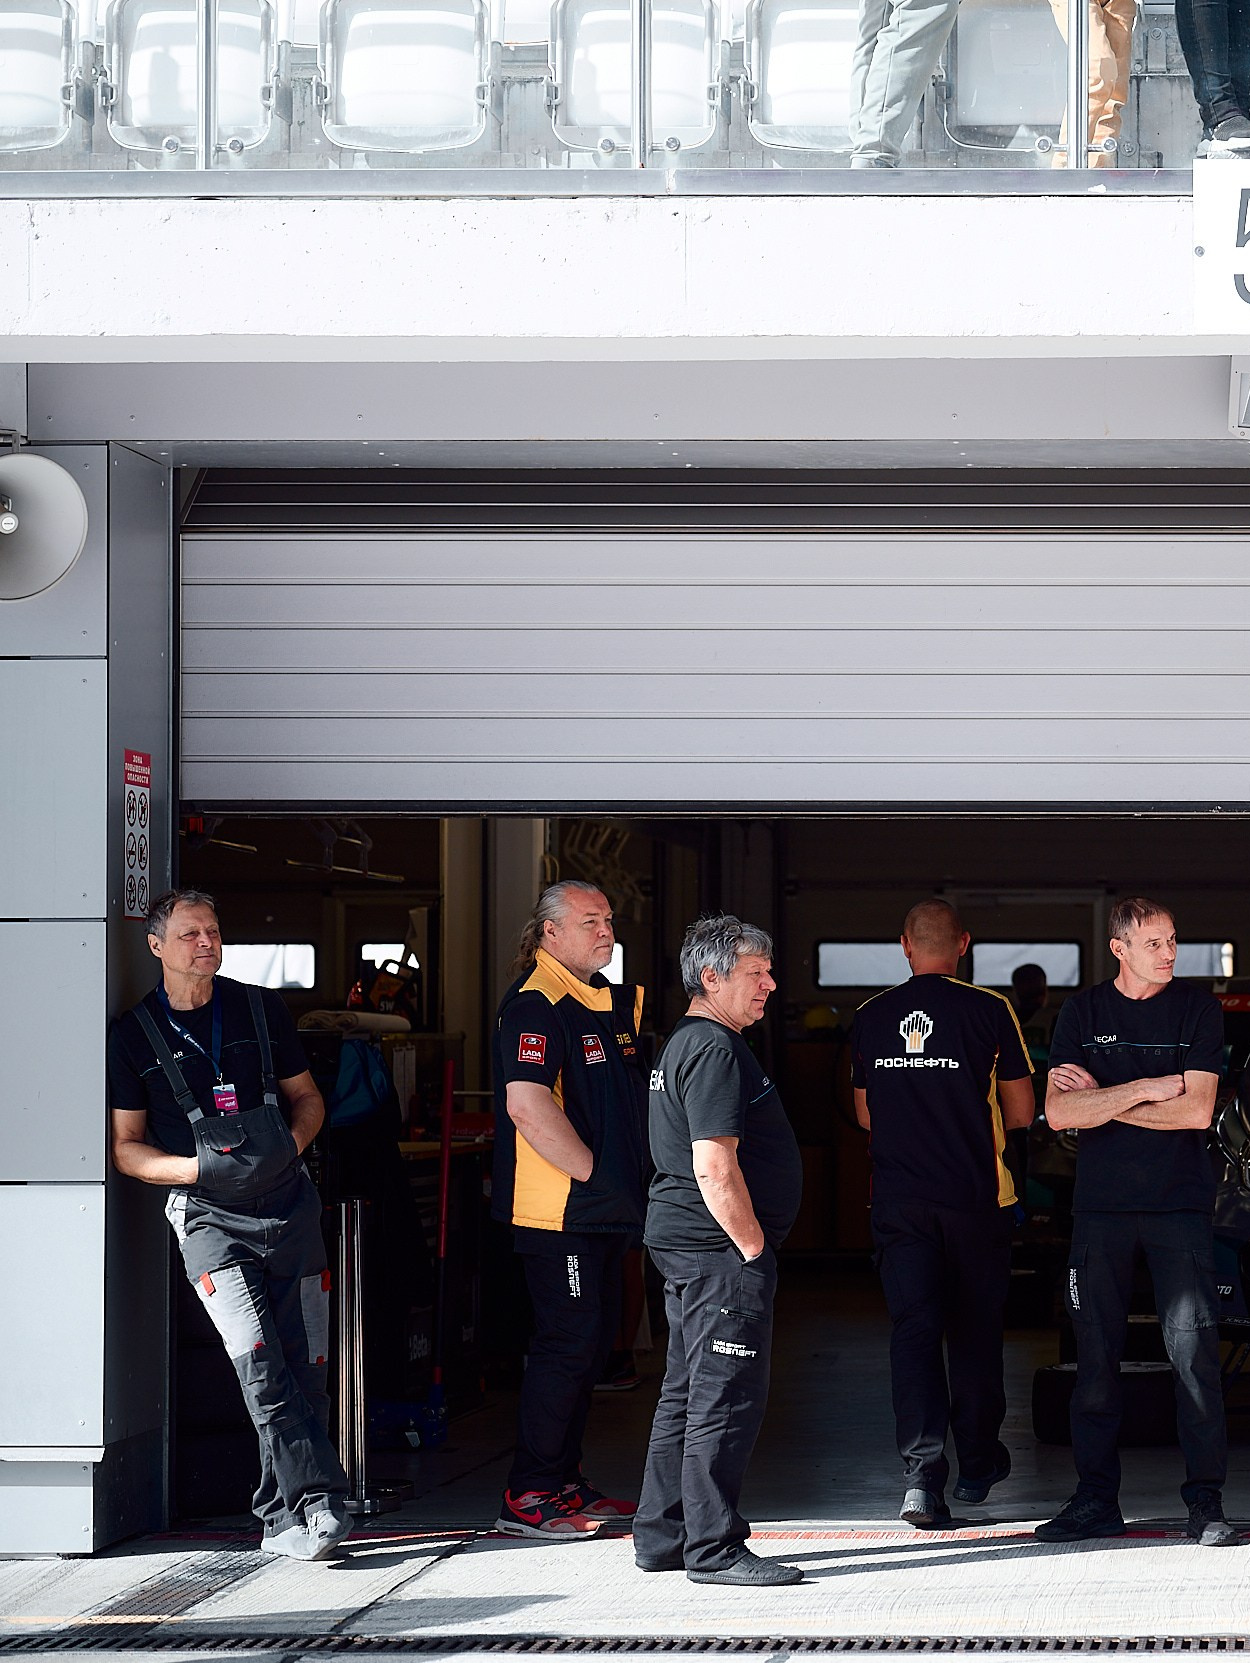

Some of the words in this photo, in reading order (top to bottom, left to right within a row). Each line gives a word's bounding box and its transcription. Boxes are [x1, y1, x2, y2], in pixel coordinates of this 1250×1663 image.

[1094, 1034, 1117, 1044] LECAR
[522, 1049, 542, 1058] LADA
[585, 1050, 602, 1058] LADA
[874, 1057, 960, 1069] РОСНЕФТЬ
